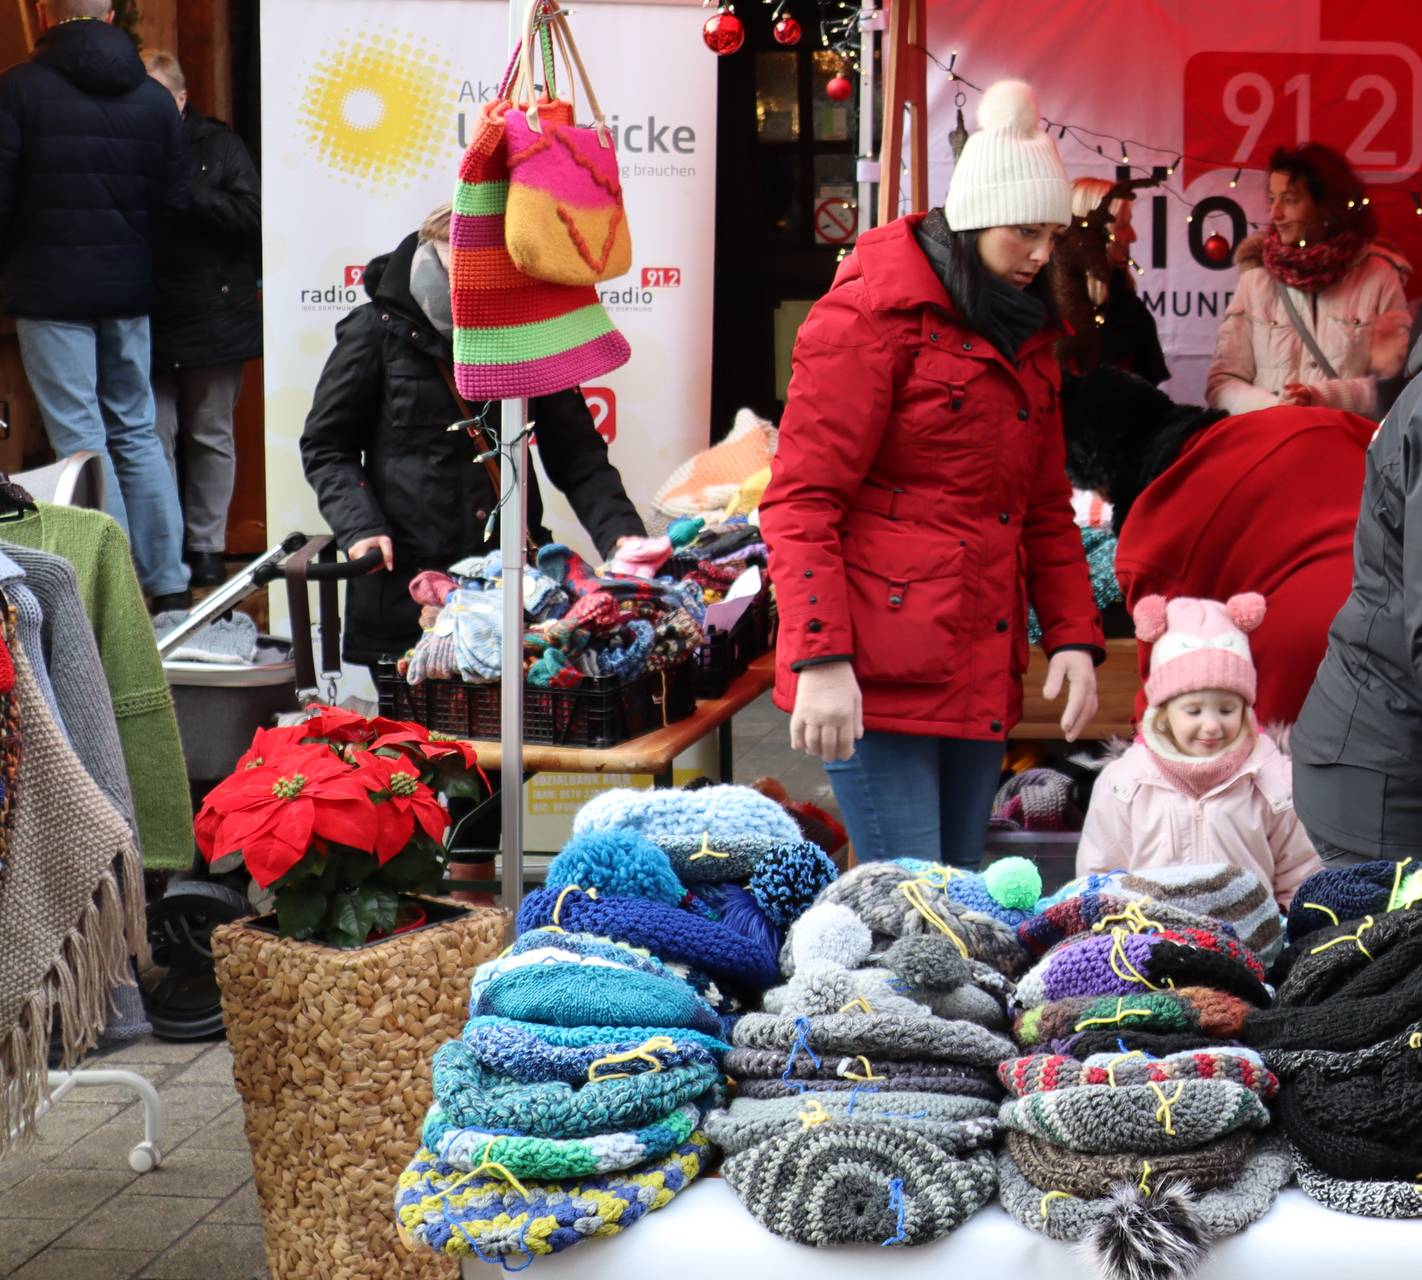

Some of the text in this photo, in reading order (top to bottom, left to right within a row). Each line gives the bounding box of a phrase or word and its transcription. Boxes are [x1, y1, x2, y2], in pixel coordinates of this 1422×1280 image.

[1222, 72, 1398, 164] 912
[634, 163, 696, 177] brauchen
[646, 270, 679, 287] 91.2
[301, 285, 357, 303] radio
[600, 286, 653, 304] radio
